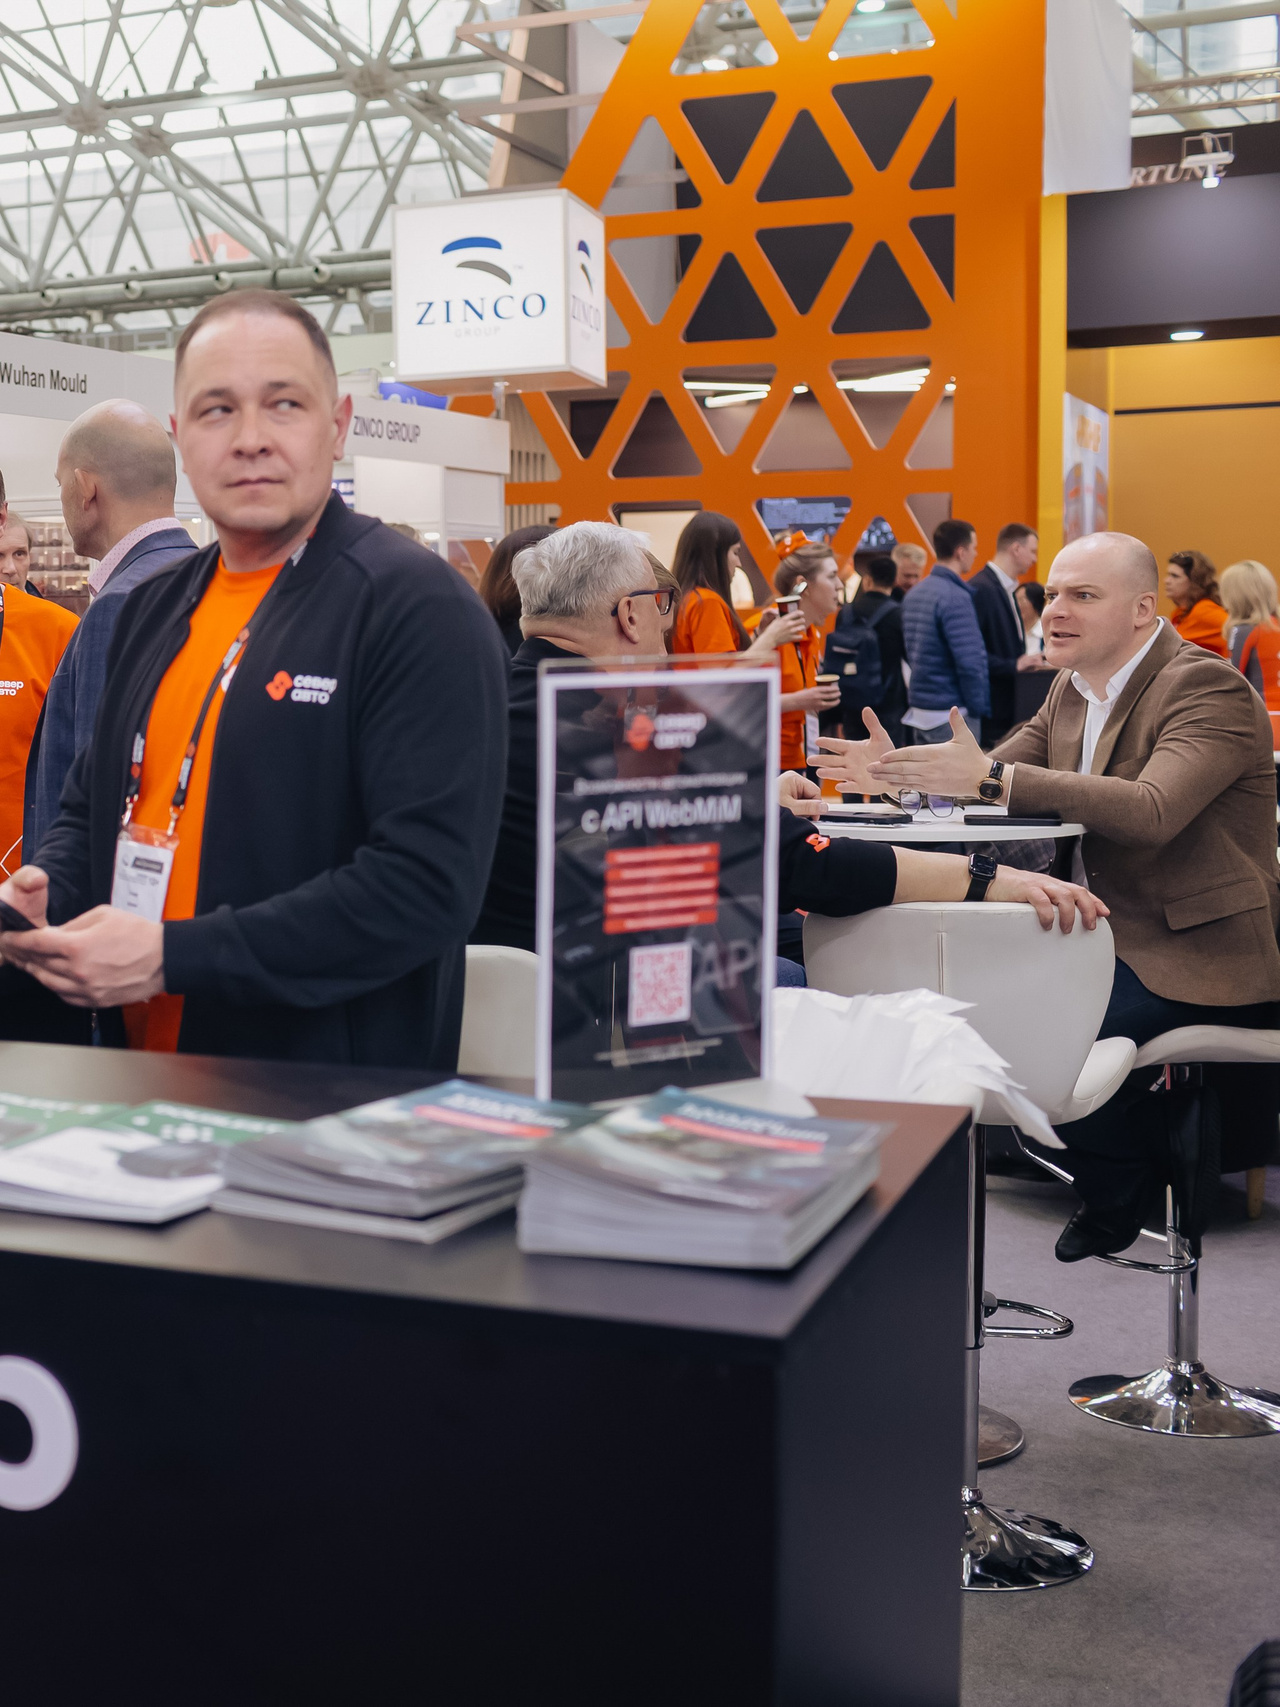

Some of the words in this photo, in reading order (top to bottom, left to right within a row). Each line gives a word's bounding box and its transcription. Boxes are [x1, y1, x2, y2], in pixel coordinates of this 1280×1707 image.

[1131, 163, 1227, 188] RTUN
[416, 293, 546, 325] ZINCO
[454, 326, 501, 338] GROUP
[50, 369, 87, 394] Mould
[353, 416, 384, 439] ZINCO
[386, 421, 420, 443] GROUP
